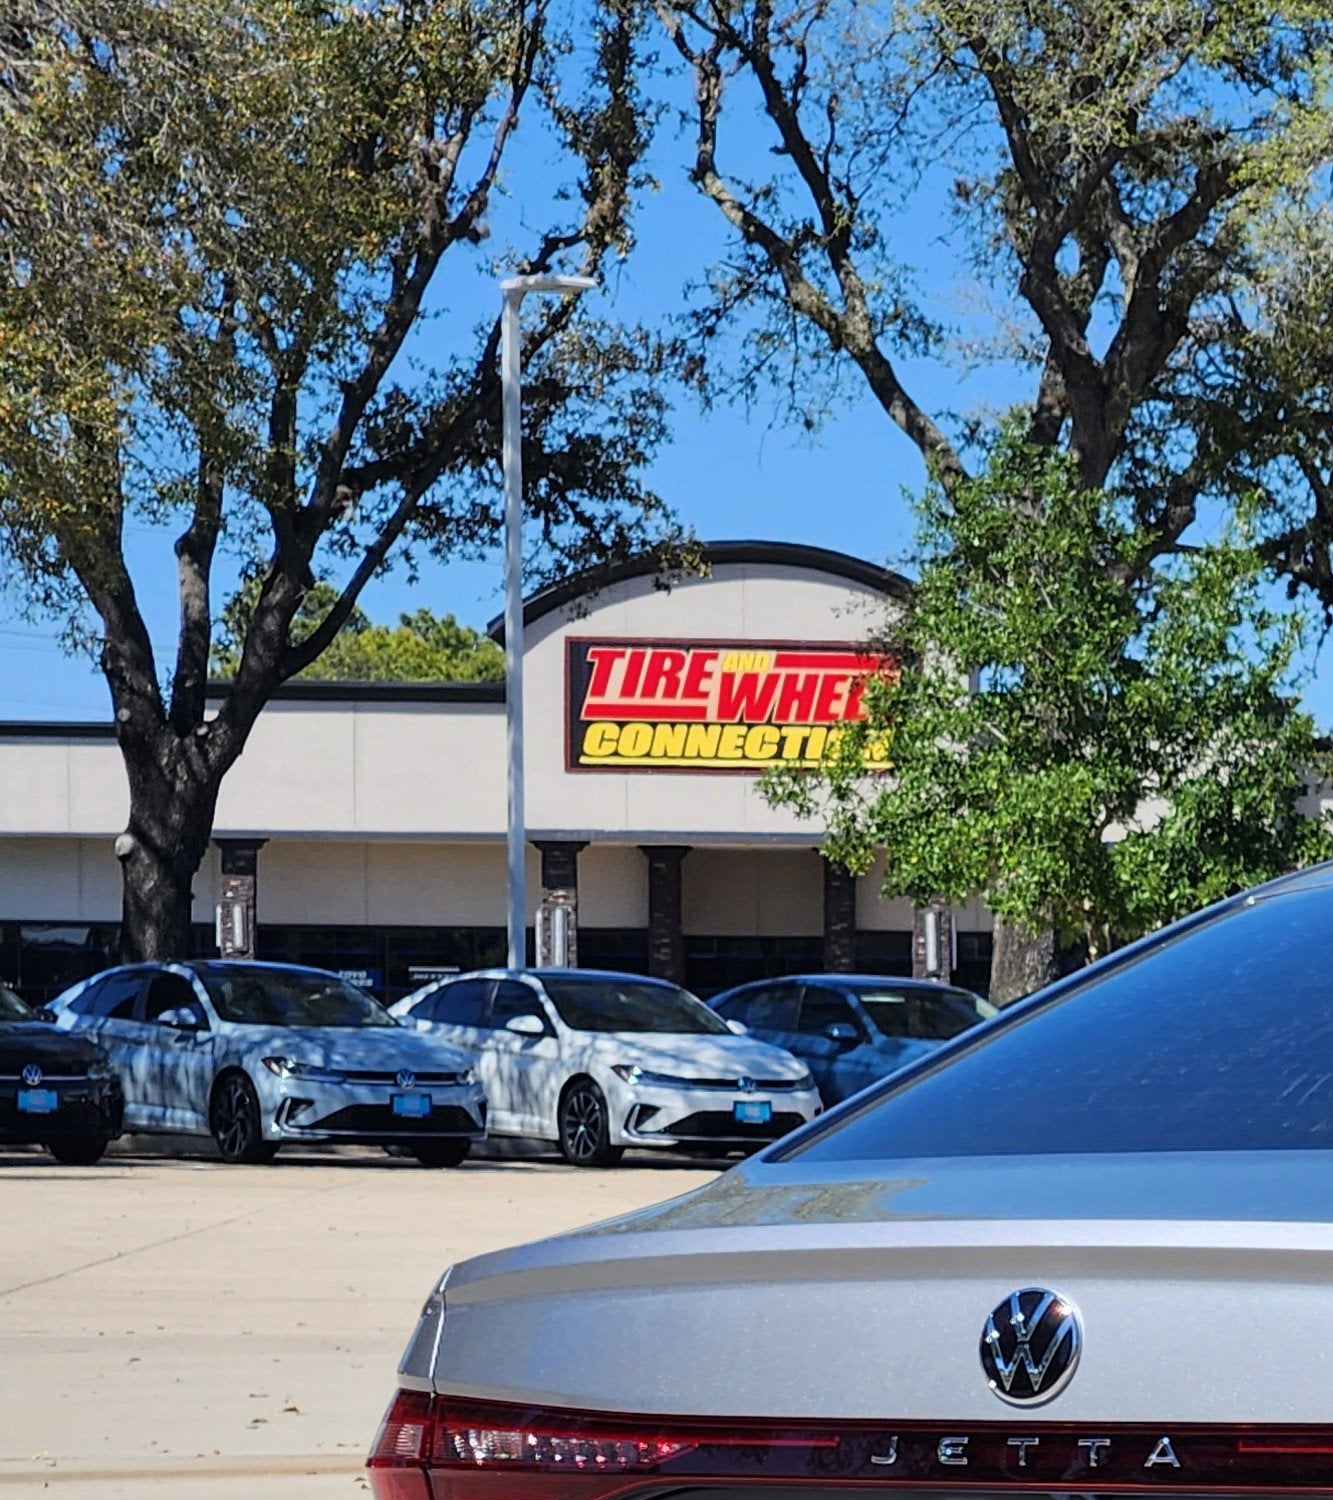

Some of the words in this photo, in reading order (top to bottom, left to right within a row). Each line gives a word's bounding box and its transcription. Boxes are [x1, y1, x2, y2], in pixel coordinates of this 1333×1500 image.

[587, 649, 719, 699] TIRE
[721, 651, 769, 673] AND
[715, 671, 900, 722] WHEE
[870, 1435, 1182, 1468] JETTA
